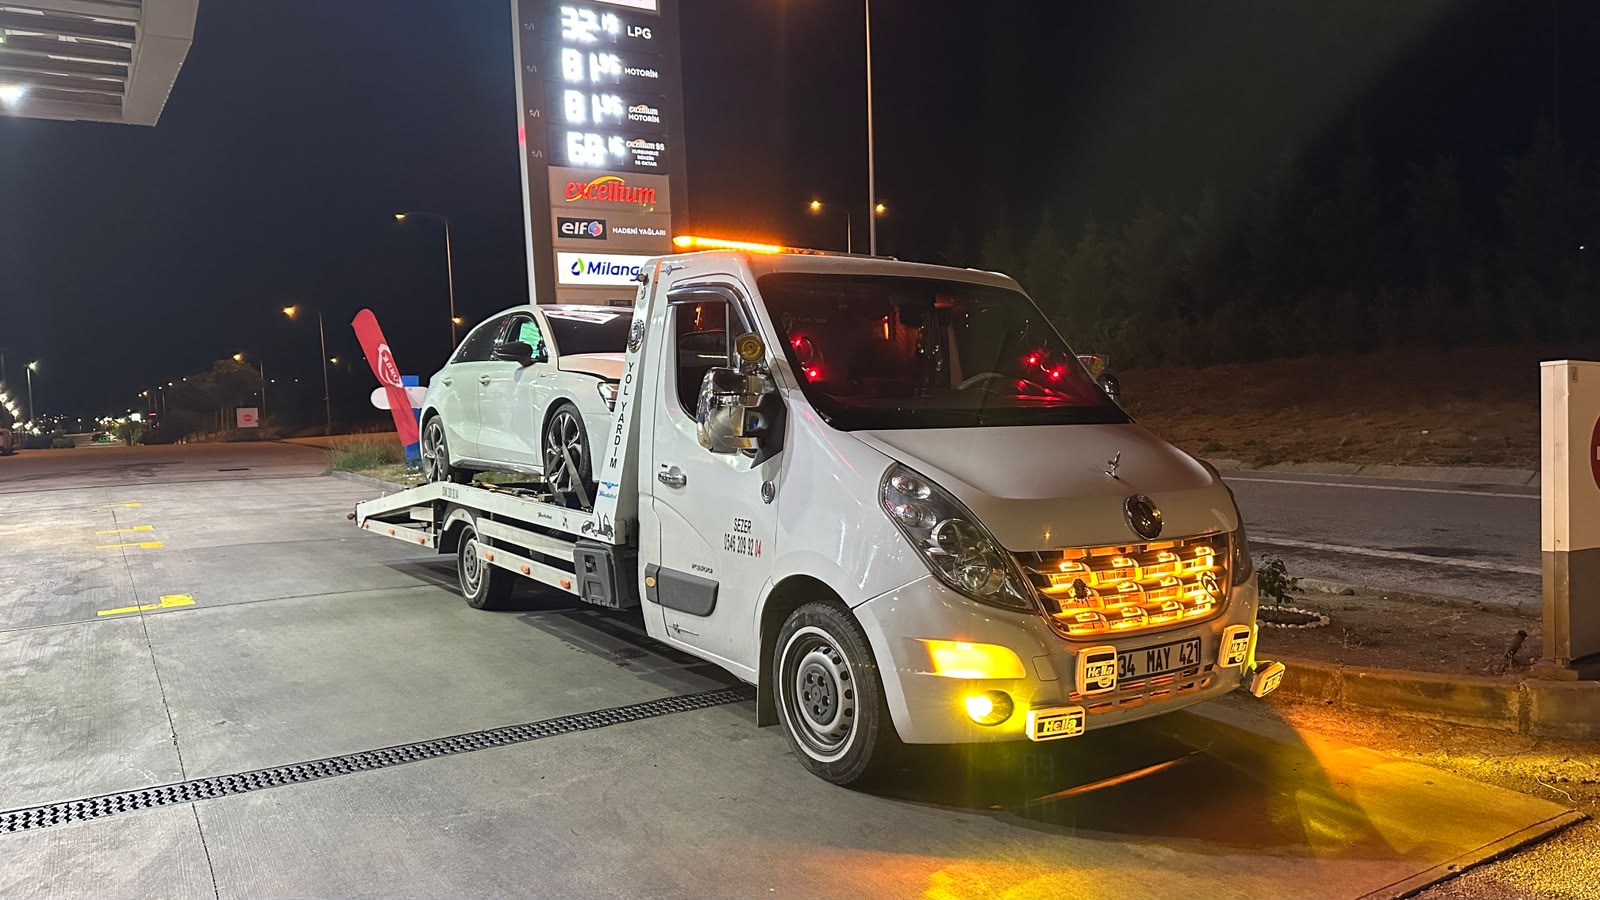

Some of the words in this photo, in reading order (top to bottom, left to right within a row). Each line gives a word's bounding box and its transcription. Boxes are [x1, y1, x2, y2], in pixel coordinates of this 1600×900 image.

[627, 25, 652, 40] LPG
[624, 67, 658, 79] MOTORİN
[565, 177, 656, 205] excellium
[561, 221, 588, 235] elf
[587, 260, 644, 282] Milang
[623, 361, 635, 396] YOL
[609, 401, 628, 468] YARDIM
[733, 517, 752, 534] SEZER
[1117, 653, 1136, 678] 34
[1146, 647, 1171, 673] MAY
[1179, 639, 1199, 665] 421
[1087, 664, 1113, 678] Hella
[1043, 718, 1078, 733] Hella
